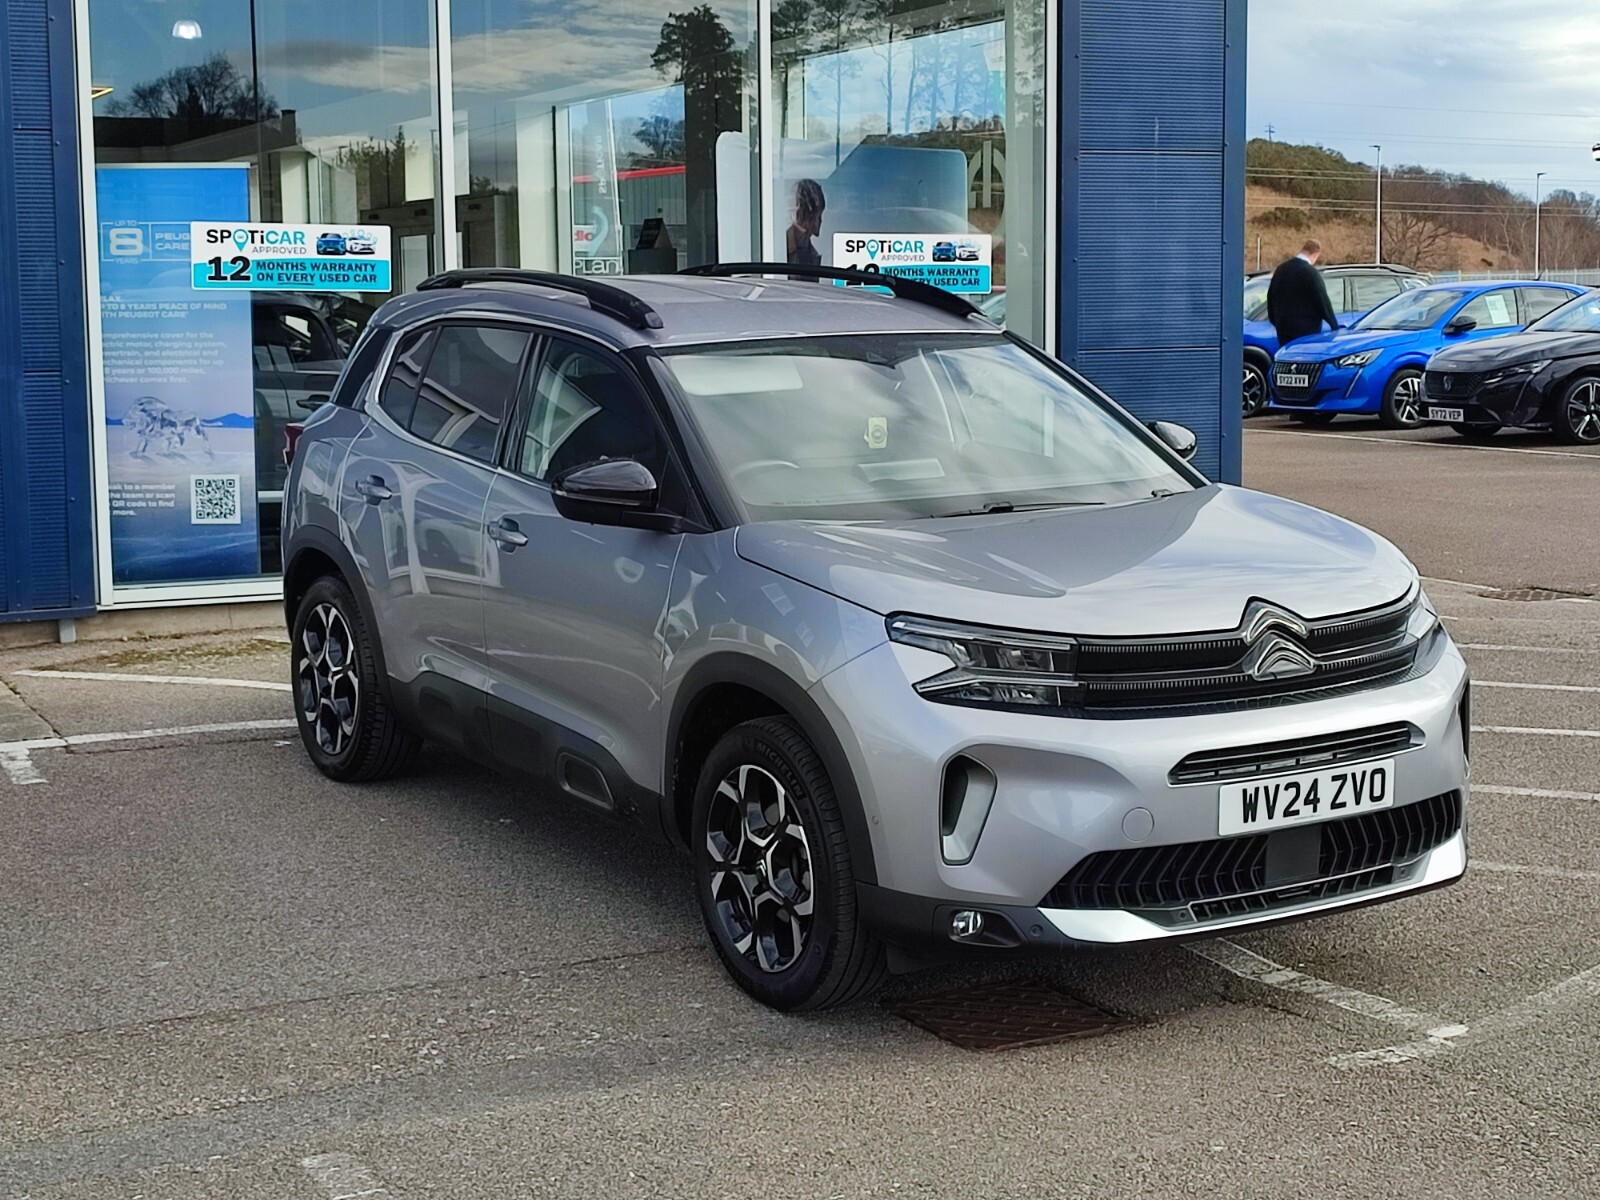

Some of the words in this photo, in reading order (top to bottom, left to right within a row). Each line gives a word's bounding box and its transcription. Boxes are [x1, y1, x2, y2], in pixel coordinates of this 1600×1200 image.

[109, 228, 144, 256] 8
[252, 246, 307, 255] APPROVED
[881, 254, 925, 262] APPROVED
[207, 255, 251, 282] 12
[256, 261, 306, 272] MONTHS
[310, 263, 376, 272] WARRANTY
[884, 268, 924, 277] MONTHS
[928, 268, 980, 277] WARRANTY
[257, 272, 274, 282] ON
[278, 272, 315, 283] EVERY
[320, 274, 352, 283] USED
[354, 274, 377, 283] CAR
[934, 277, 959, 286] USED
[963, 278, 980, 286] CAR
[118, 311, 159, 319] PEUGEOT
[112, 500, 125, 508] QR
[158, 500, 175, 508] find
[1242, 778, 1320, 824] WV24
[1330, 767, 1386, 811] ZVO
